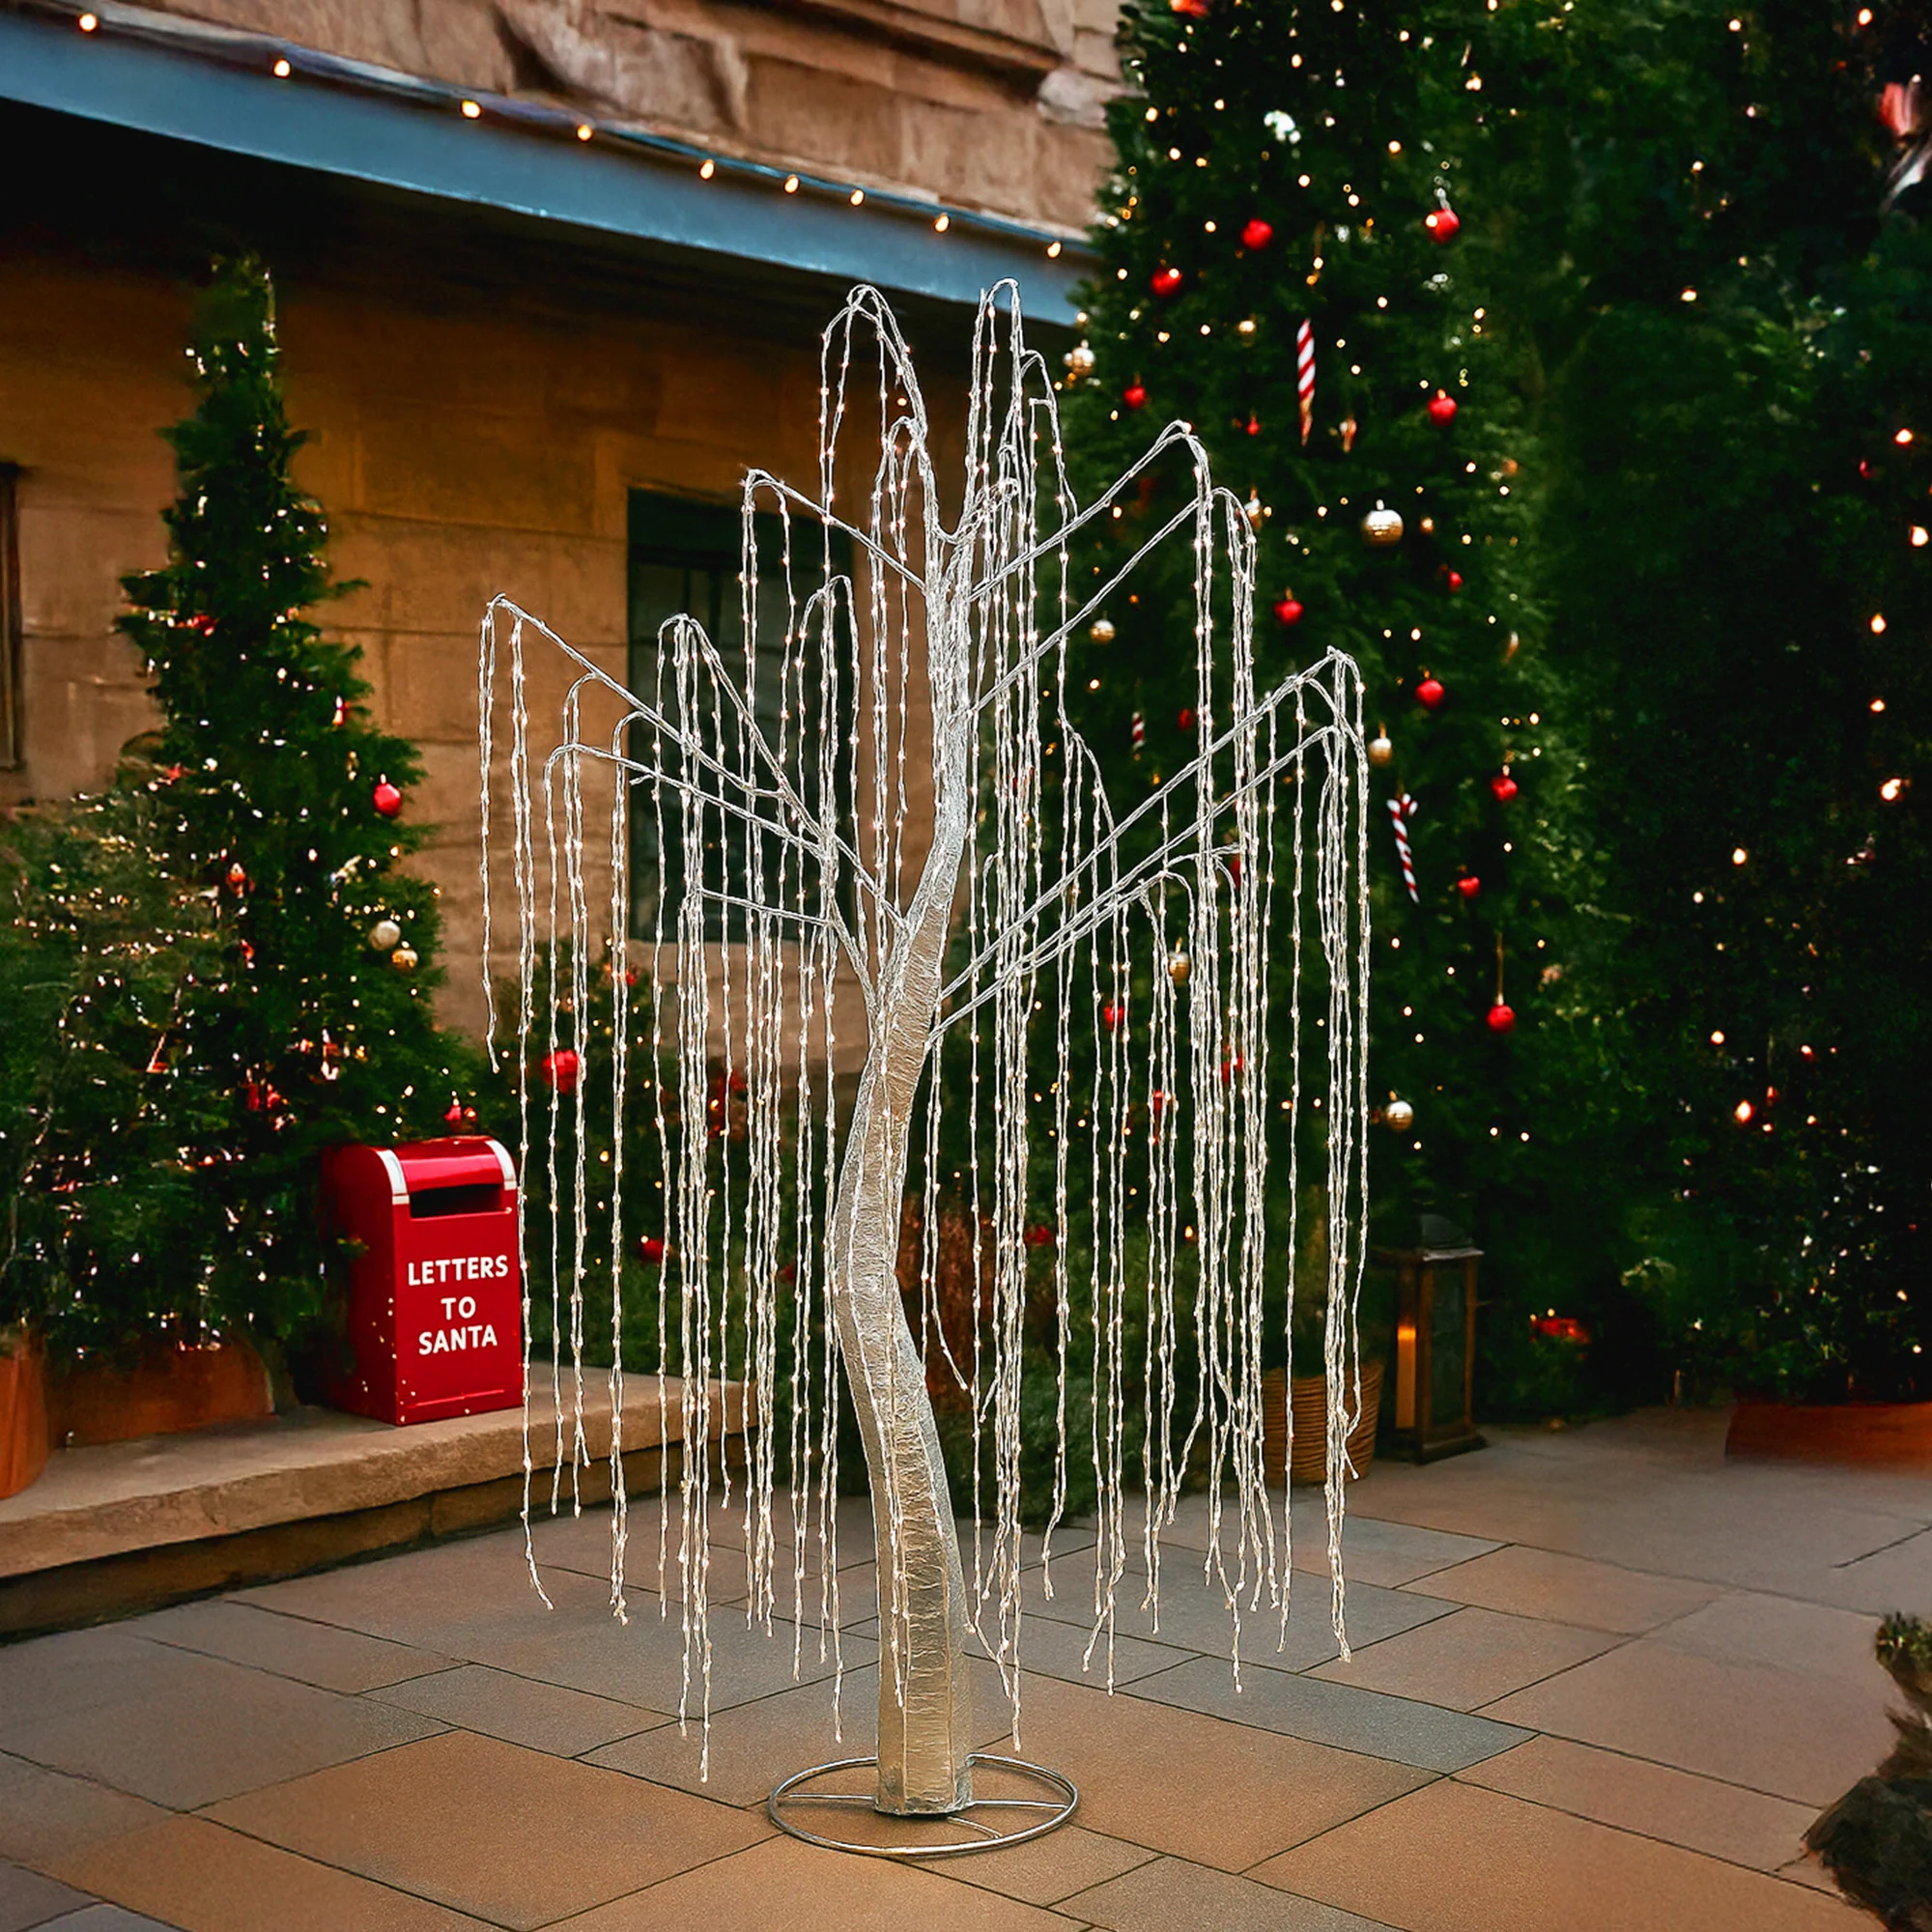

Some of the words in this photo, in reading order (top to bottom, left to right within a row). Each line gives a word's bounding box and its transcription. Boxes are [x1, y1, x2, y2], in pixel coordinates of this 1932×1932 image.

[408, 1255, 509, 1286] LETTERS
[440, 1296, 476, 1320] TO
[418, 1324, 497, 1355] SANTA
